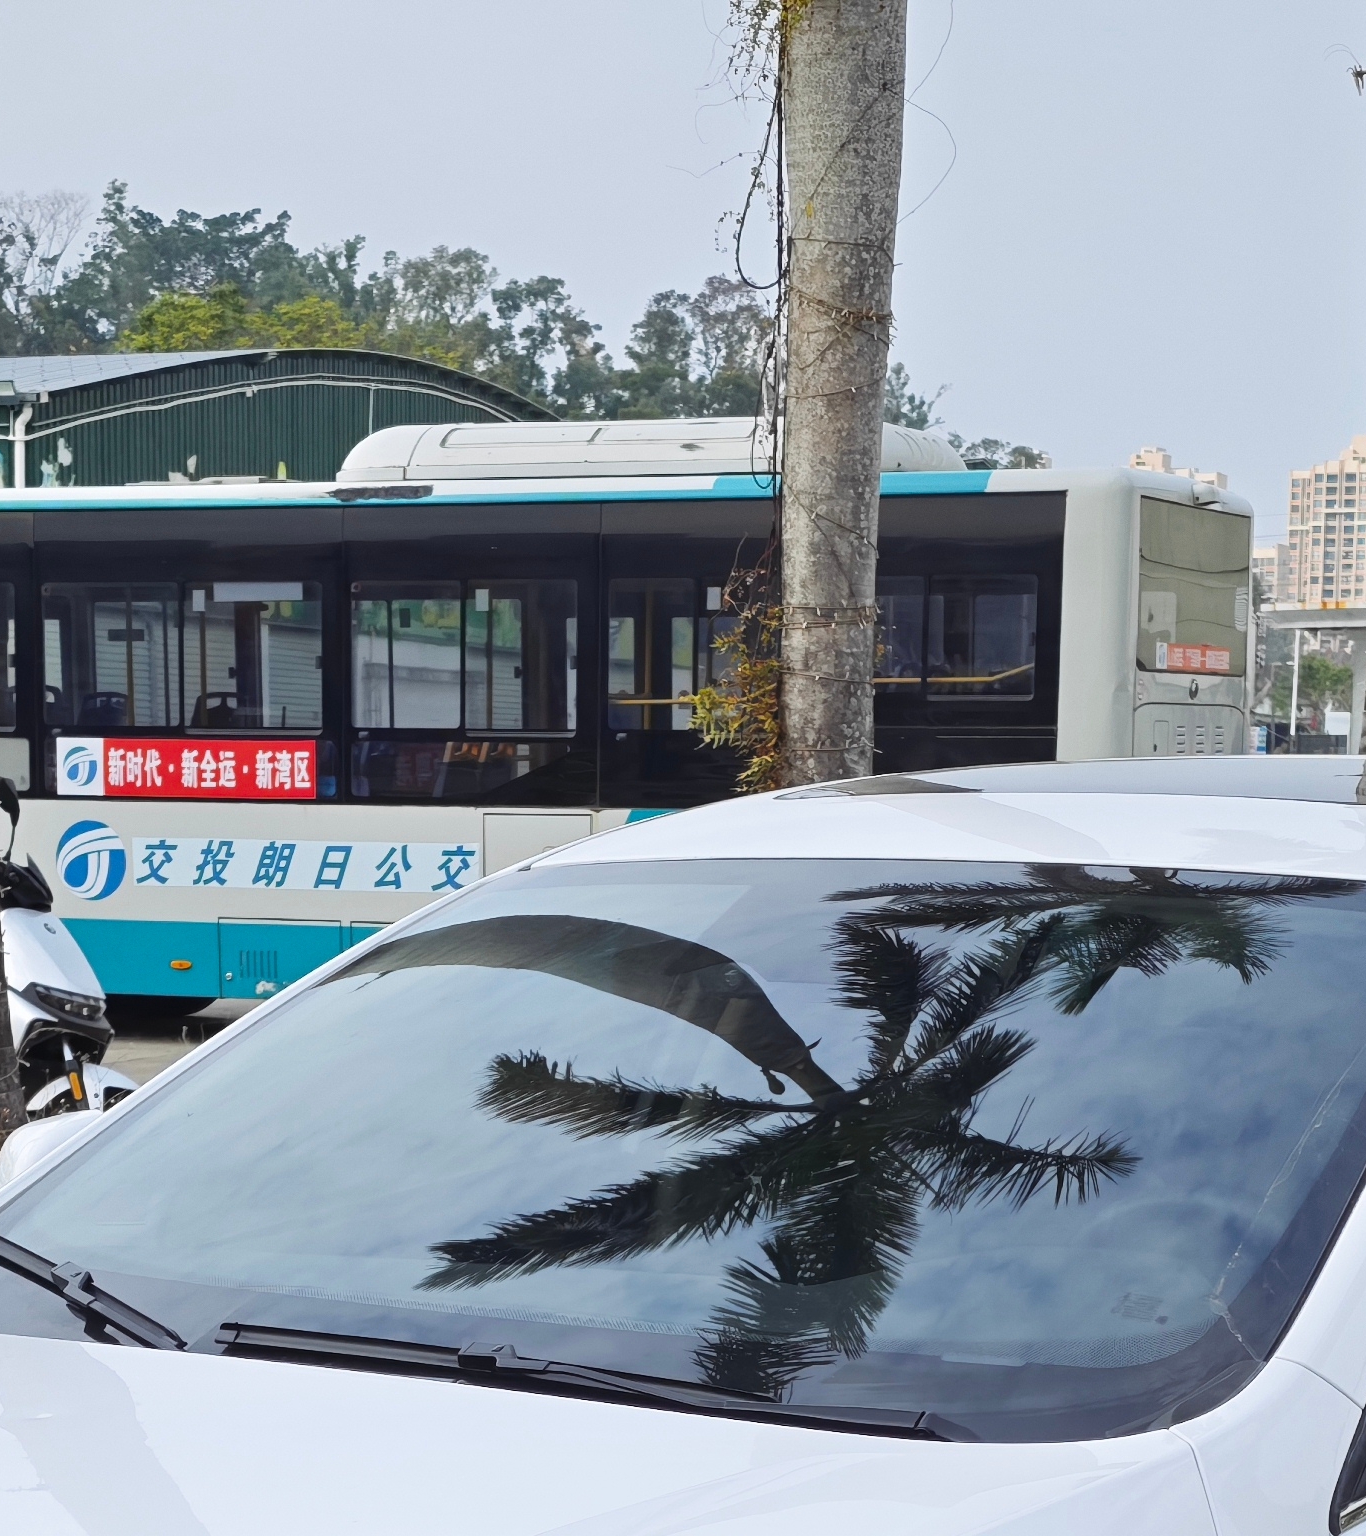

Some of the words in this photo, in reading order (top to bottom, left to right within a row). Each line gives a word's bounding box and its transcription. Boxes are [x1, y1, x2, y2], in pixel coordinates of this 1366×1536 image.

[134, 838, 477, 890] 交投朗日公交
